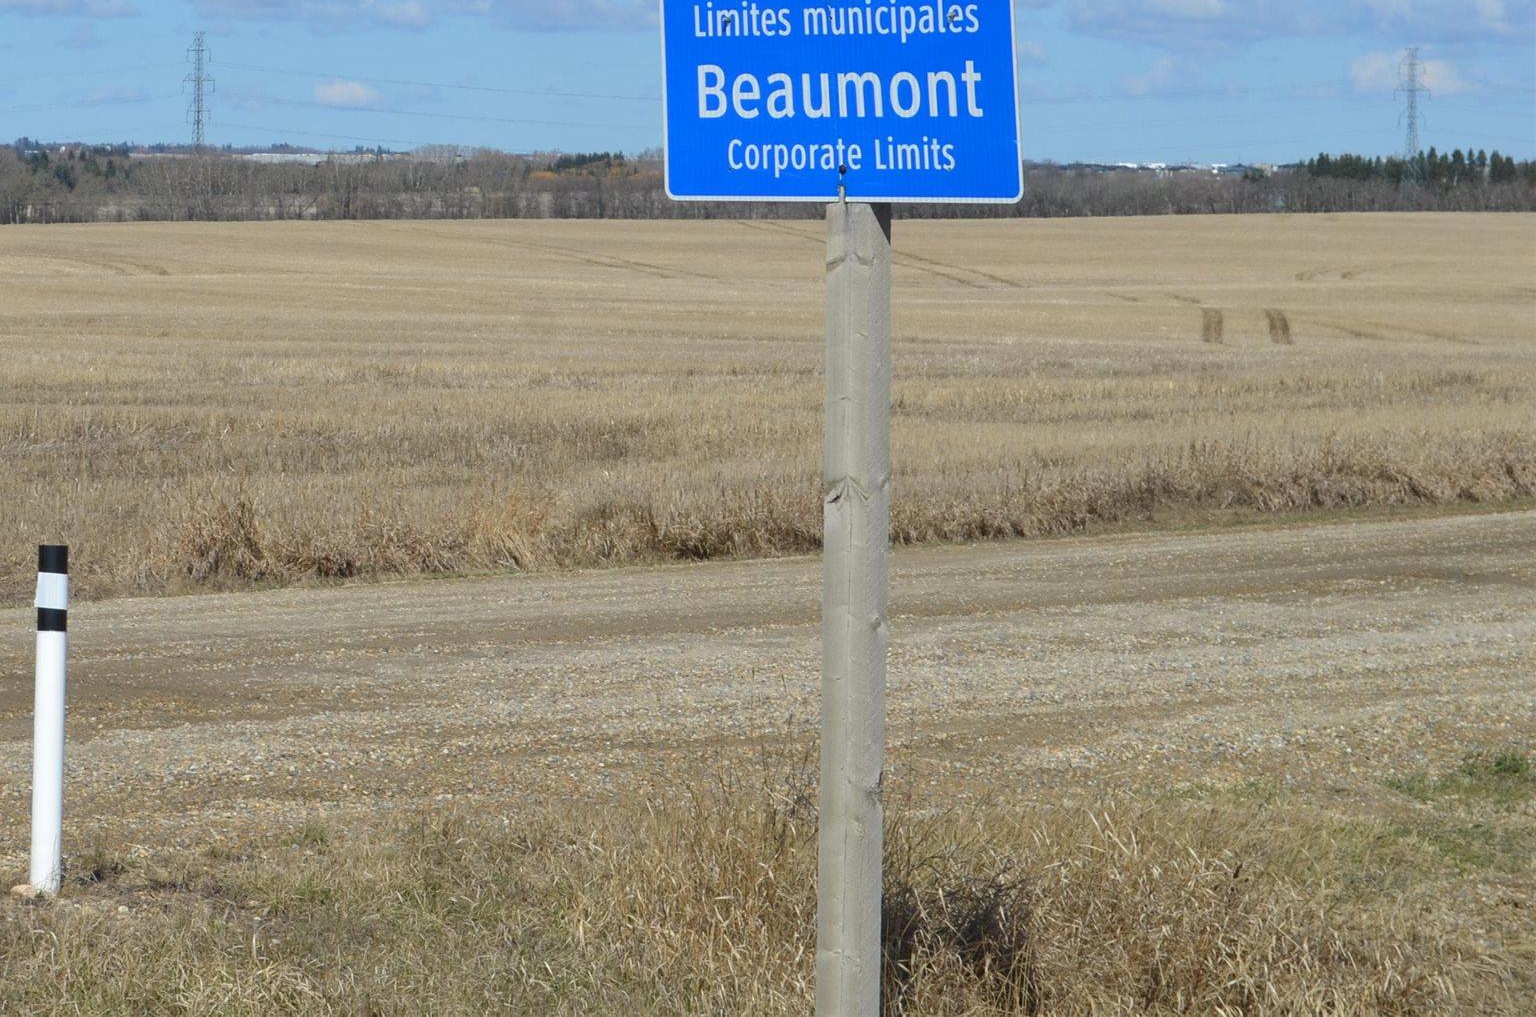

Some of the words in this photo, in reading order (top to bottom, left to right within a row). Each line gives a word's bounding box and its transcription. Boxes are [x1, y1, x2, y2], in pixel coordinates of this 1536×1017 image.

[693, 1, 792, 38] Limites
[697, 60, 984, 119] Beaumont
[727, 138, 863, 178] Corporate
[874, 136, 956, 171] Limits
